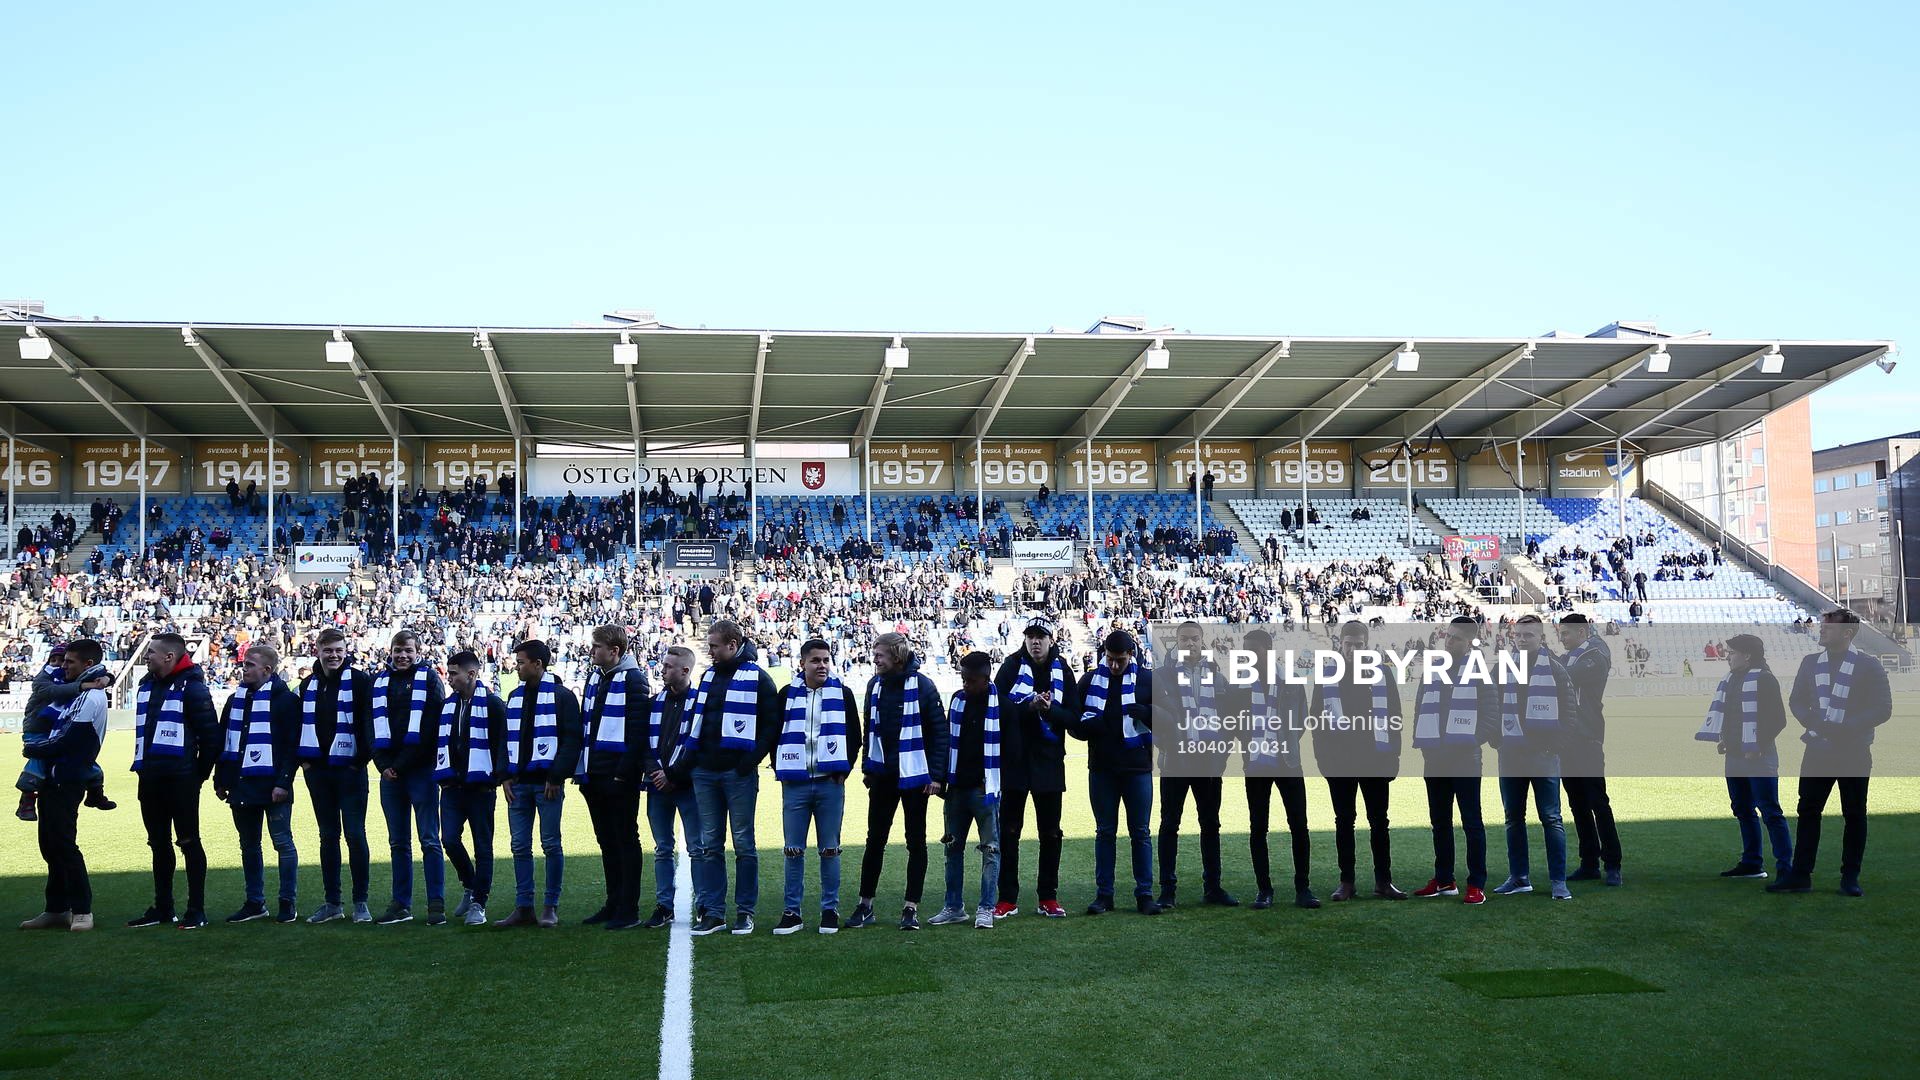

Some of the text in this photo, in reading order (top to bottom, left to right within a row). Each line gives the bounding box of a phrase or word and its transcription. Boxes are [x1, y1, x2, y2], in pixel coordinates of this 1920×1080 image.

[83, 460, 170, 486] 1947
[202, 460, 290, 486] 1948
[563, 464, 787, 484] ÖSTGÖTAPORTEN
[869, 460, 944, 484] 1957
[970, 460, 1048, 484] 1960
[1072, 460, 1148, 484] 1962
[1271, 460, 1344, 484] 1989
[1370, 460, 1448, 482] 2015
[1560, 468, 1600, 477] stadium
[1454, 717, 1471, 725] PEKING
